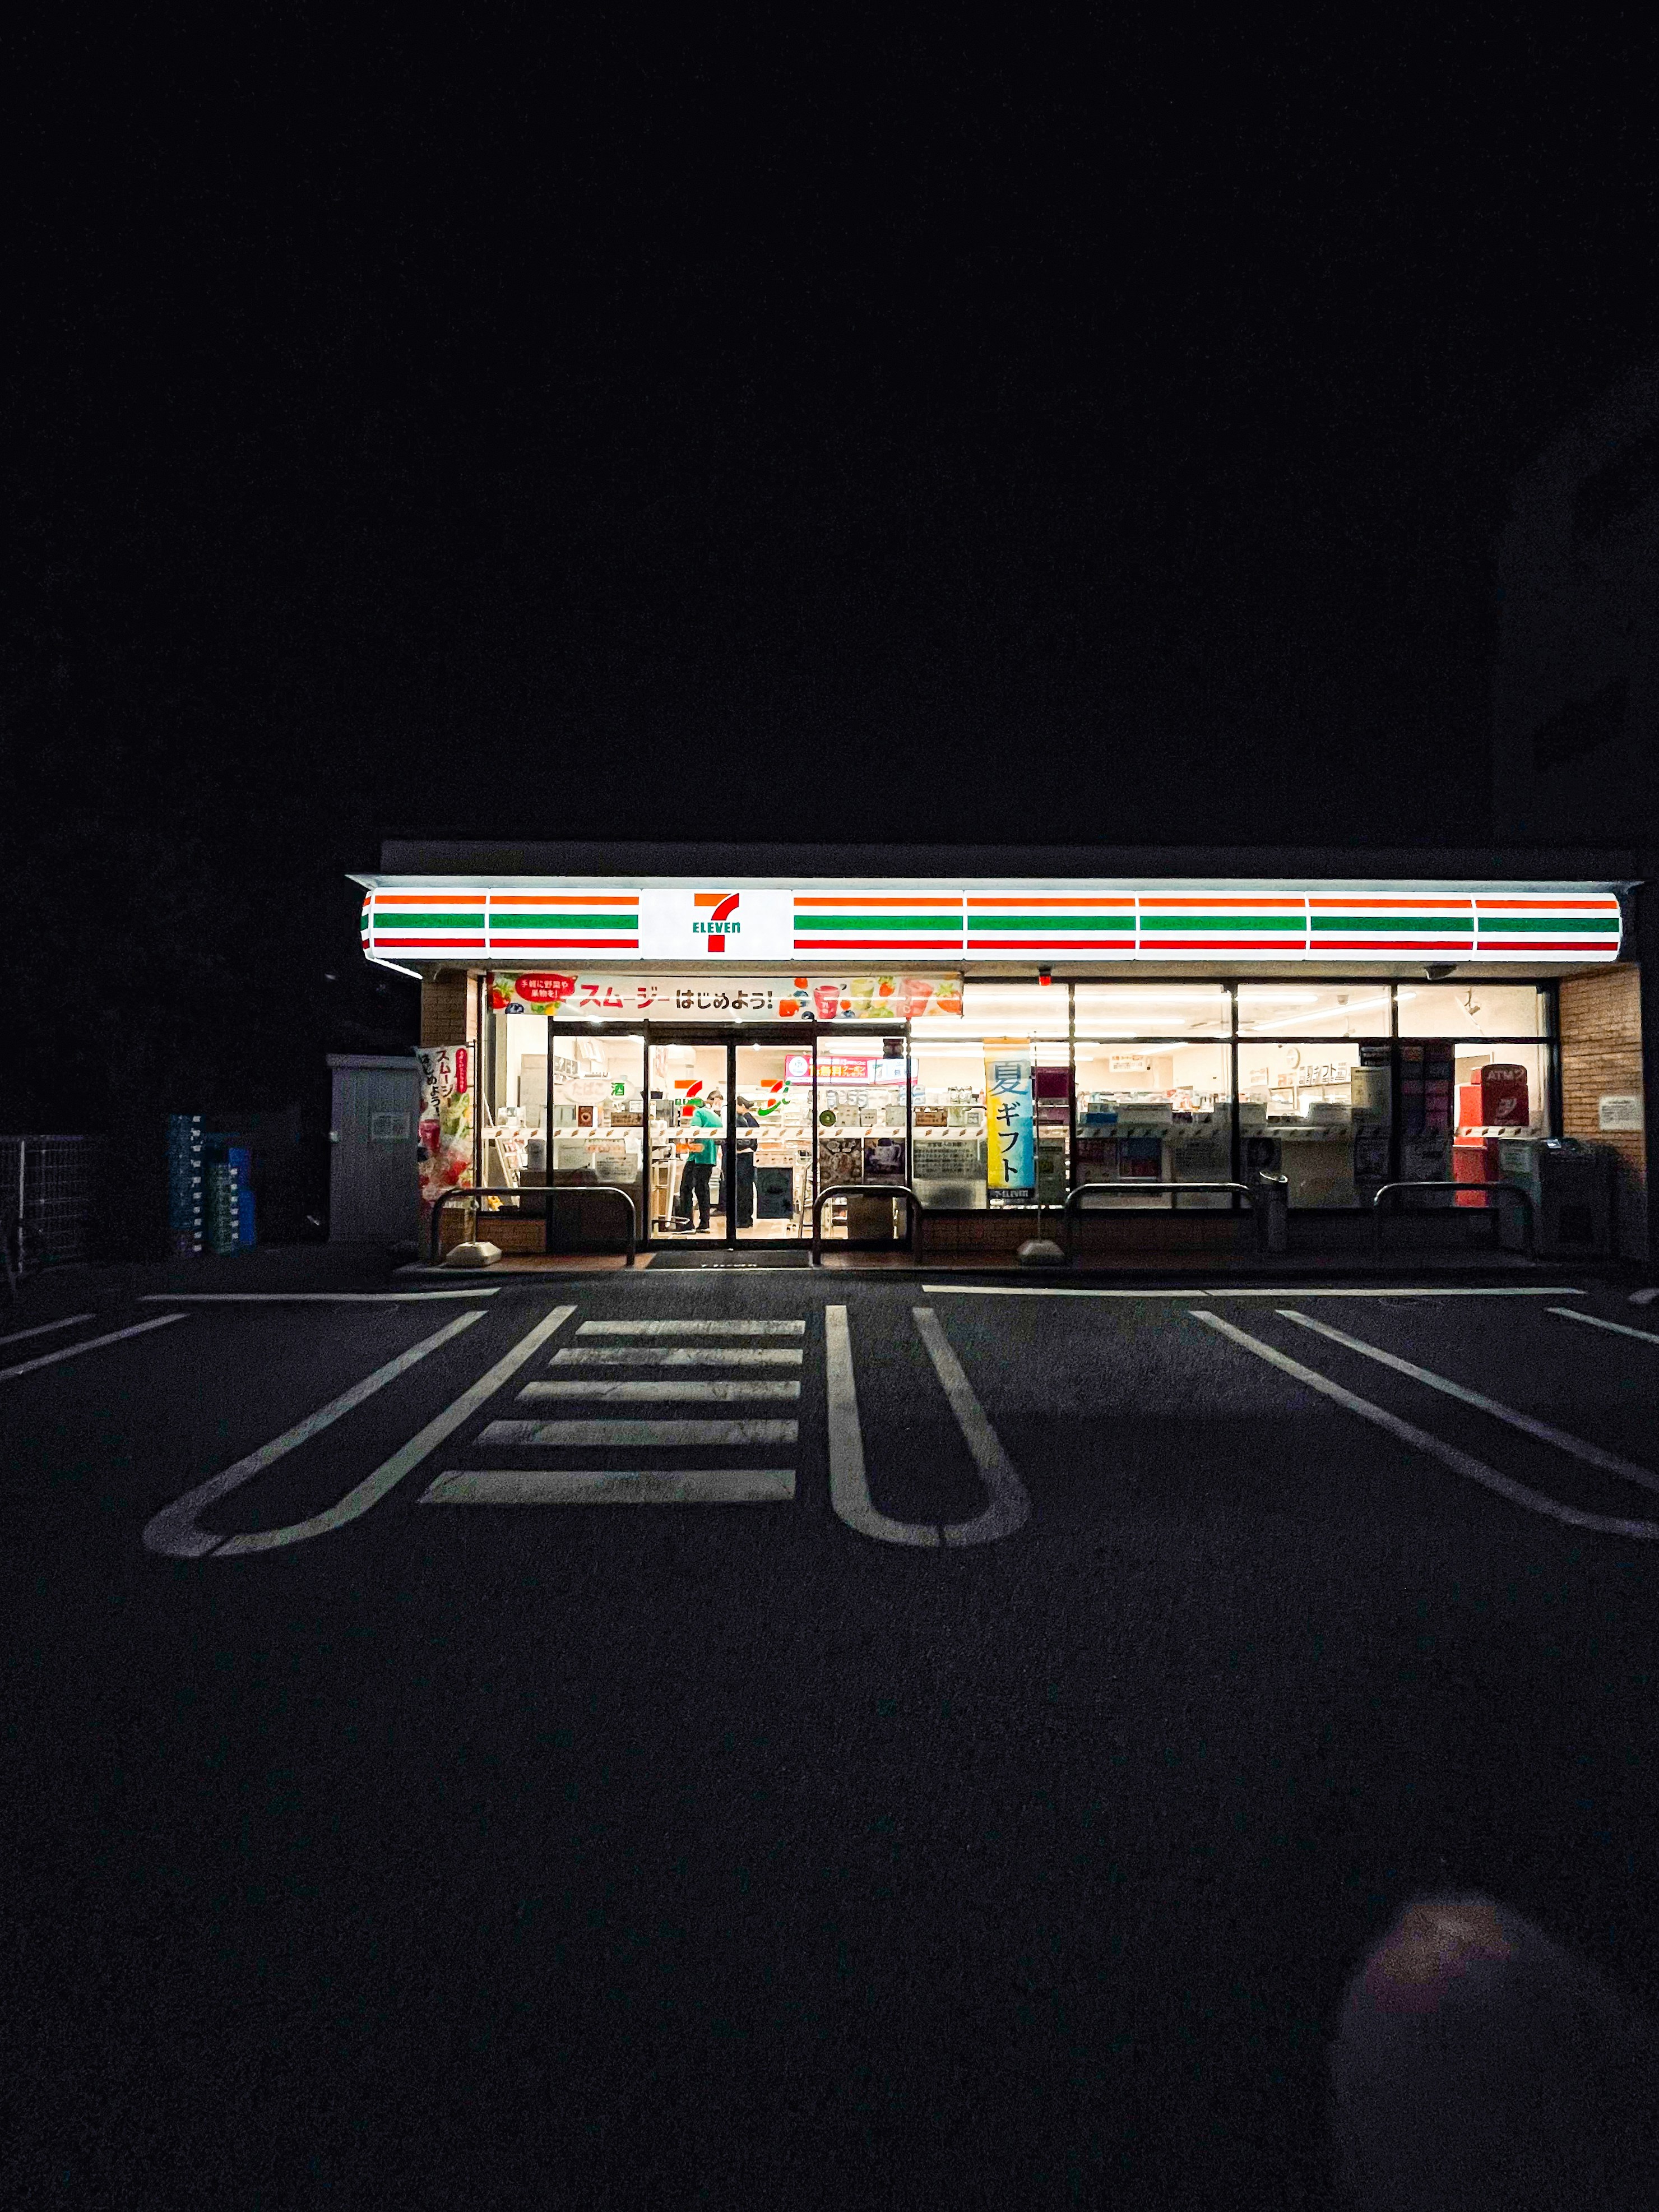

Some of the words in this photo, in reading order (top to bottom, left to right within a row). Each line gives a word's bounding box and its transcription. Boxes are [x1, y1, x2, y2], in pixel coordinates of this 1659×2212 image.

[521, 980, 568, 989] 手軽に野菜や
[580, 984, 670, 1008] スムージー
[676, 989, 773, 1009] はじめよう!
[1487, 1070, 1513, 1080] ATM
[611, 1082, 624, 1096] 酒
[989, 1064, 1028, 1183] 夏ギフト
